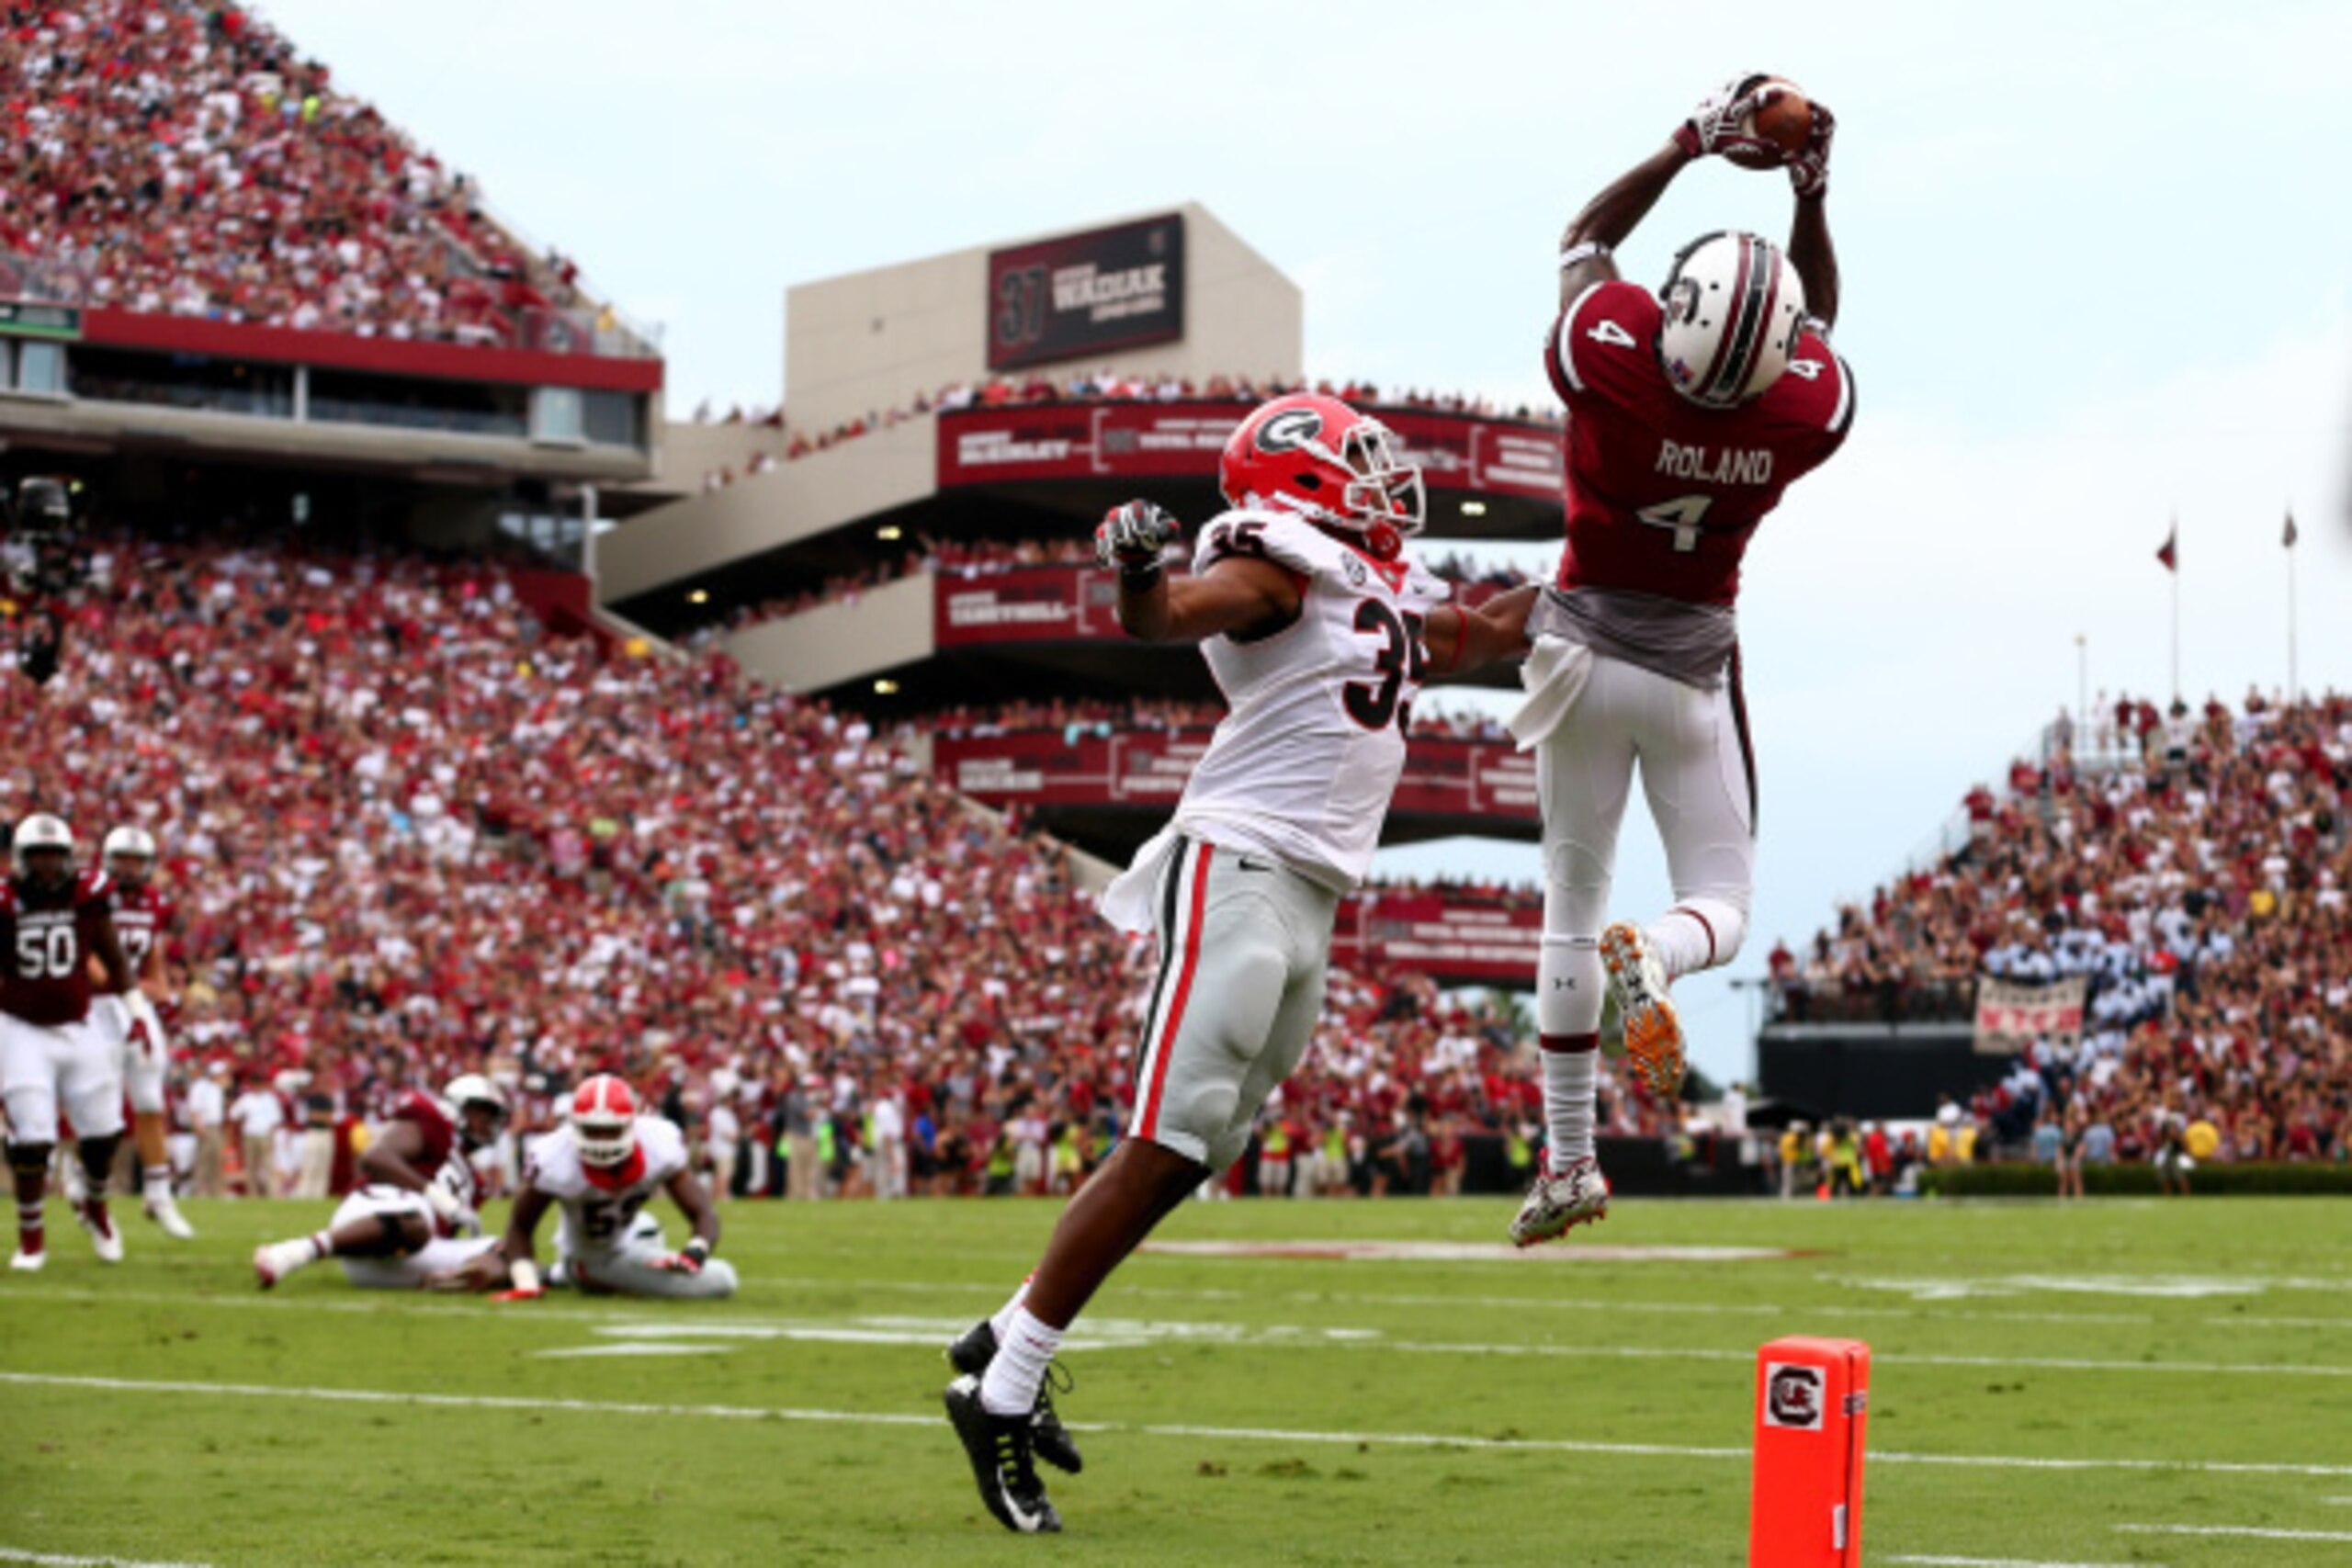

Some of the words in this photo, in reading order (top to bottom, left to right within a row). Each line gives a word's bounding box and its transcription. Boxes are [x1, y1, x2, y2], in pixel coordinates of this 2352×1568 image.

[998, 265, 1046, 345] 37
[1587, 320, 1637, 349] 4
[1787, 357, 1826, 381] 4
[1655, 438, 1774, 484] ROLAND
[1635, 494, 1714, 552] 4
[16, 924, 78, 980] 50
